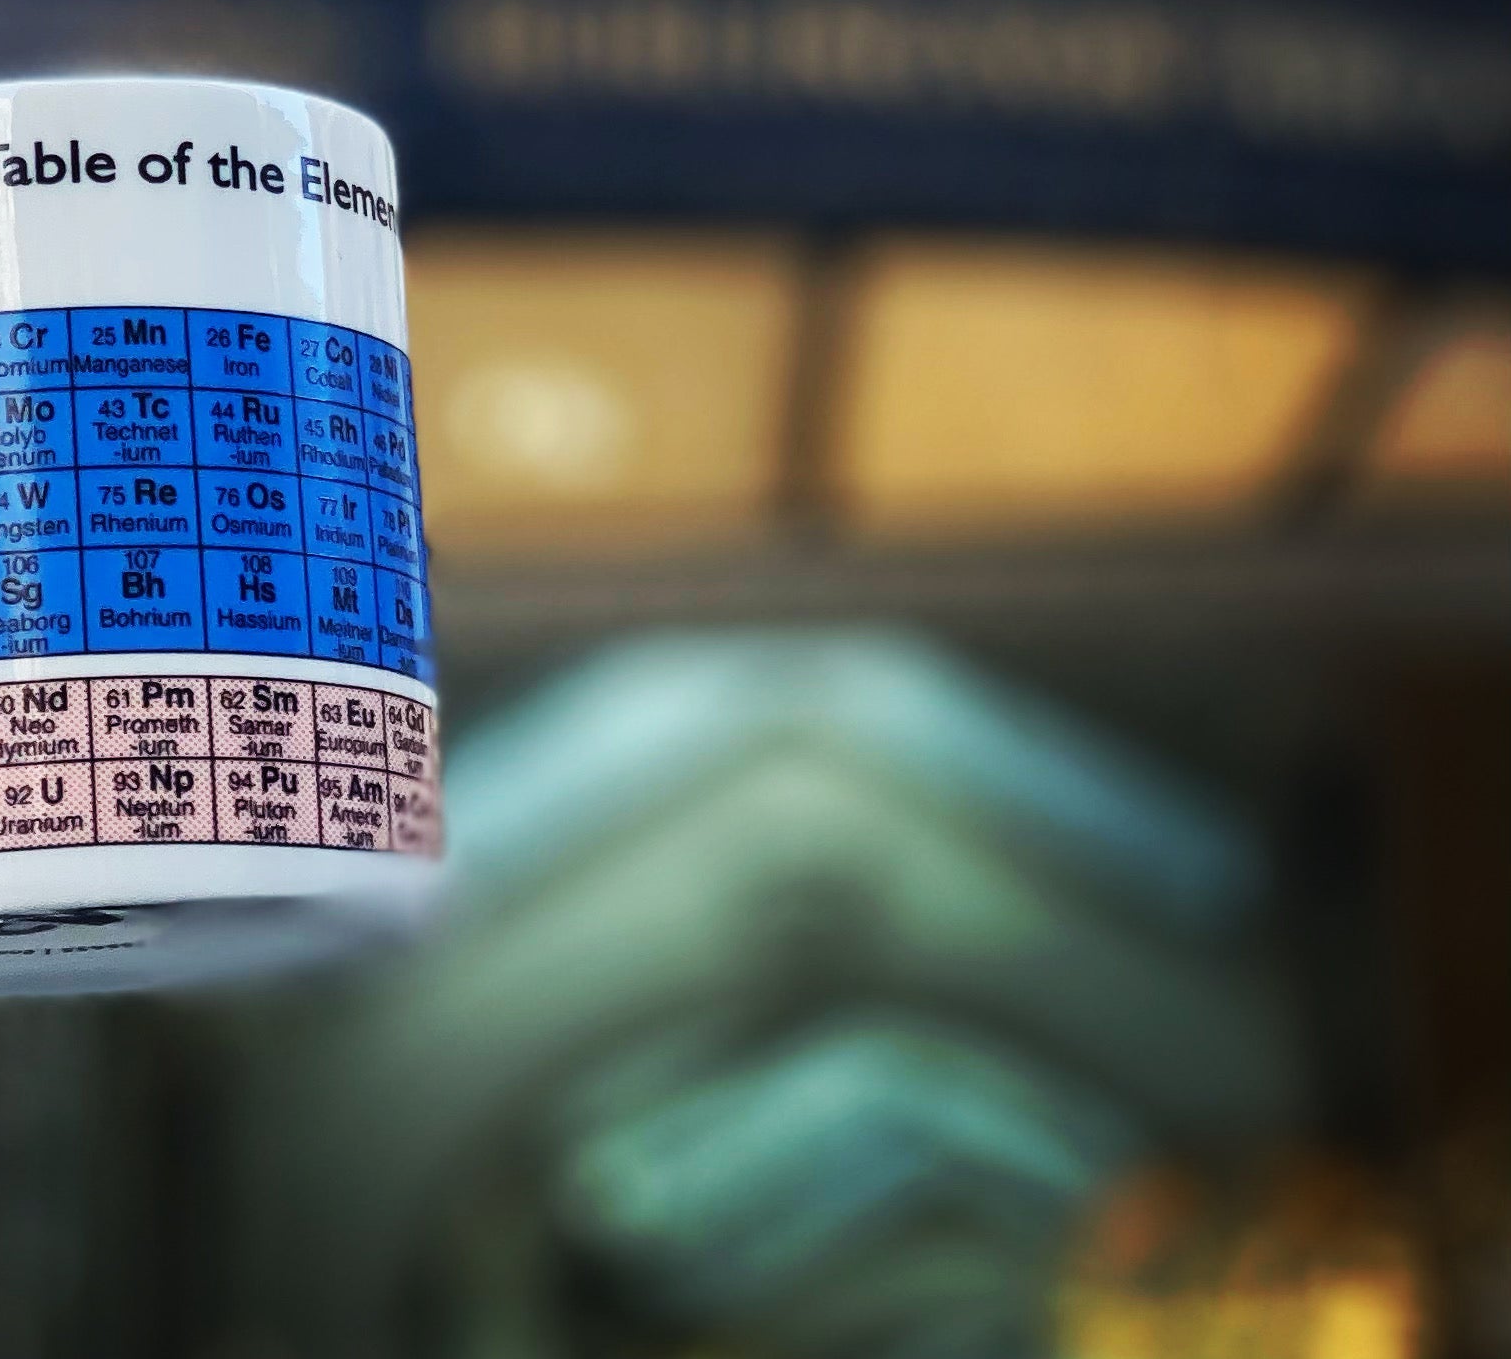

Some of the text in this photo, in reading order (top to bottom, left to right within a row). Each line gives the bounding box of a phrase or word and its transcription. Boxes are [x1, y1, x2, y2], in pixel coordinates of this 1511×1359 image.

[138, 141, 194, 185] of
[207, 145, 284, 194] the
[9, 322, 48, 350] Cr
[92, 318, 167, 347] 25 Mn
[206, 323, 271, 352] 26 Fe
[300, 336, 353, 367] 27 Co
[73, 354, 188, 378] Manganese
[223, 355, 260, 377] Iron
[5, 395, 55, 424] Mo
[97, 391, 170, 420] 43 Tc
[210, 396, 280, 425] 44 Ru
[92, 421, 179, 441] Technet
[214, 423, 282, 448] Ruthen
[304, 414, 357, 445] 45 Rh
[114, 442, 161, 462] -ium
[229, 446, 270, 466] -ium
[300, 443, 367, 471] Rhodium
[17, 481, 50, 510] W
[98, 478, 177, 506] 75 Re
[215, 482, 286, 511] 76 Os
[318, 493, 358, 521] 77 Ir
[91, 512, 188, 533] Rhenium
[211, 513, 292, 537] Osmium
[315, 524, 364, 548] Iridium
[3, 555, 39, 576] 106
[125, 550, 160, 570] 107
[241, 554, 272, 574] 108
[122, 571, 166, 599] Bh
[239, 573, 277, 604] Hs
[332, 566, 357, 586] 109
[1, 576, 42, 611] Sg
[332, 585, 359, 615] Mt
[99, 607, 191, 628] Bohrium
[217, 607, 301, 632] Hassium
[318, 615, 372, 641] Meitner
[1, 636, 48, 654] -ium
[23, 683, 68, 714] Nd
[106, 681, 195, 709] 61 Pm
[220, 684, 299, 714] 62 Sm
[10, 716, 56, 736] Neo
[105, 713, 200, 734] Prometh
[228, 714, 294, 736] Samar
[320, 698, 376, 729] 63 Eu
[130, 738, 179, 756] -ium
[241, 738, 283, 757] -ium
[317, 729, 387, 755] Europium
[4, 776, 64, 806] 92 U
[113, 764, 194, 798] 93 Np
[228, 765, 299, 795] 94 Pu
[320, 778, 342, 798] 95
[348, 774, 383, 805] Am
[116, 798, 196, 820] Neptun
[234, 796, 297, 820] Pluton
[329, 803, 382, 828] Americ
[133, 820, 181, 839] -ium
[244, 822, 288, 841] -ium
